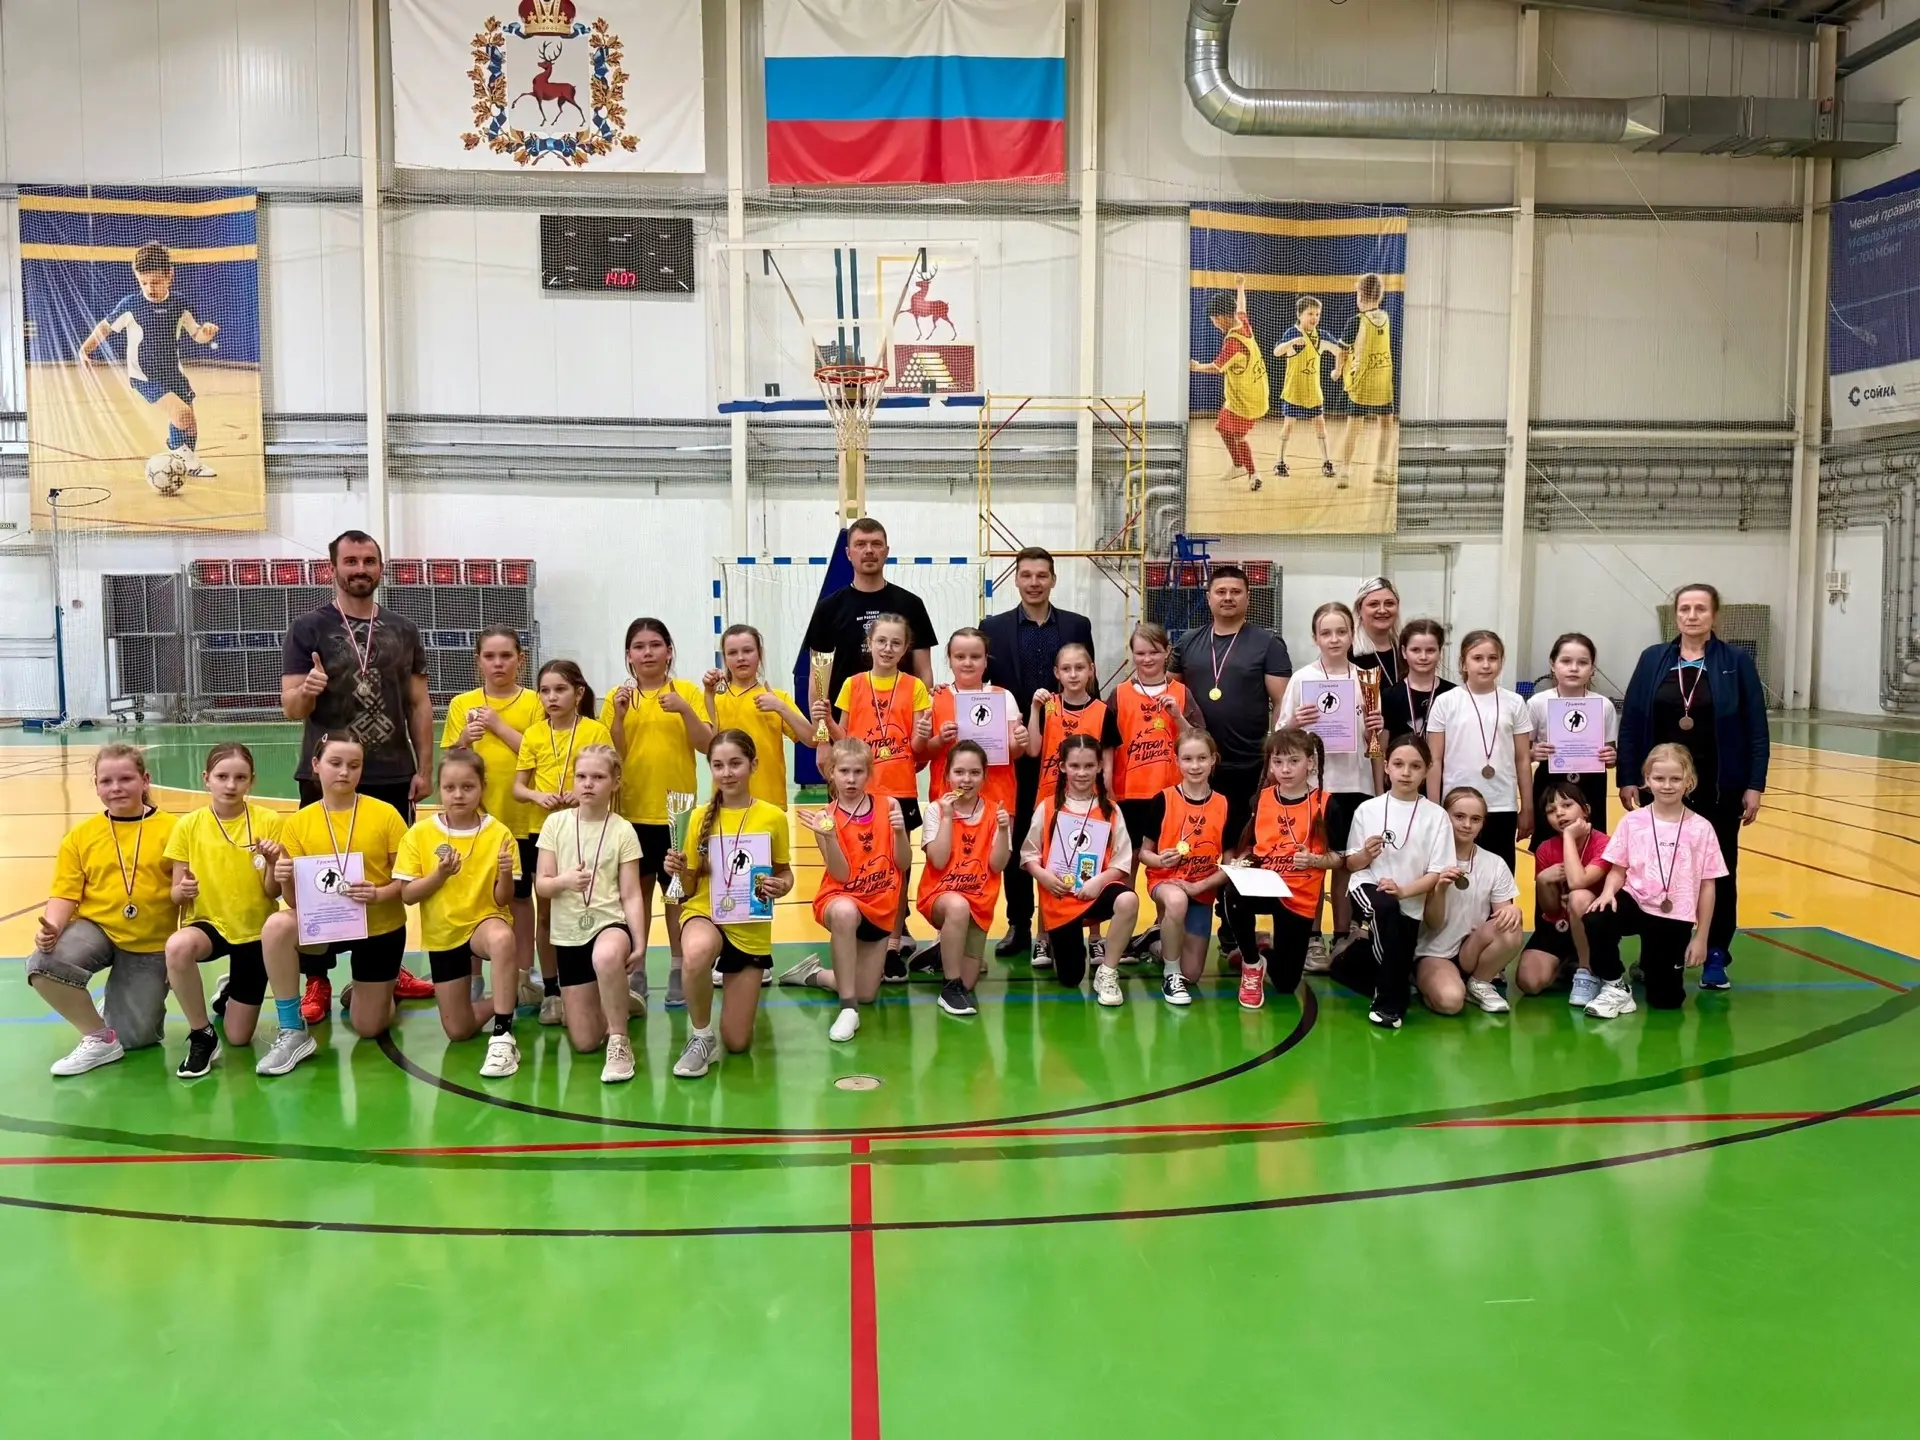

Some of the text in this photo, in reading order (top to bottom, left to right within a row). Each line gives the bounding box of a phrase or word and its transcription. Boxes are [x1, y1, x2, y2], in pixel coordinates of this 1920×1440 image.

[1849, 198, 1920, 229] Меняй правила
[1863, 384, 1897, 401] СОЙКА
